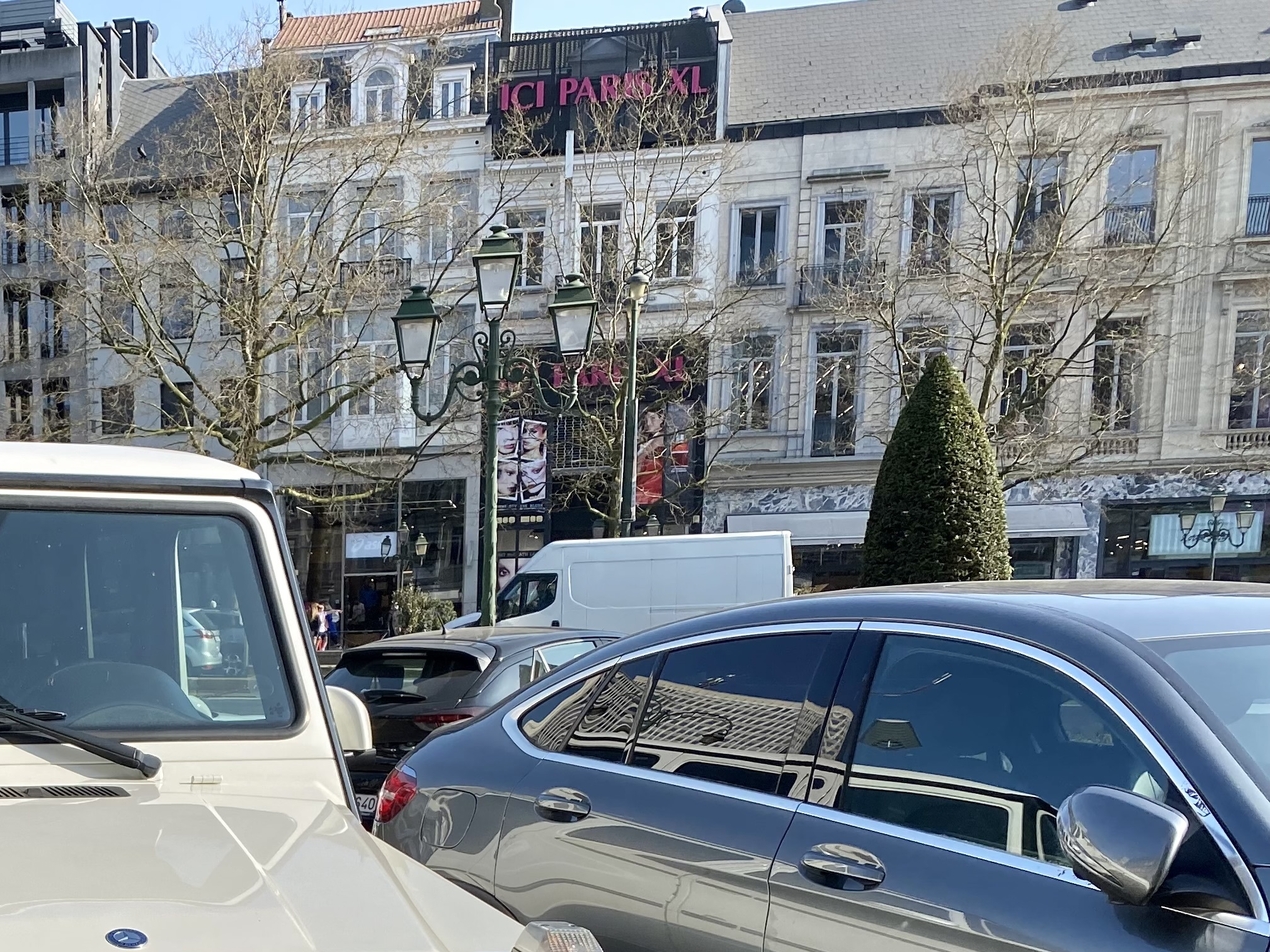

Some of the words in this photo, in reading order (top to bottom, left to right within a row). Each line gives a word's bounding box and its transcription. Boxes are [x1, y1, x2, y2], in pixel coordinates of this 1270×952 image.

[498, 80, 545, 111] ICI
[560, 69, 652, 106] PARIS
[667, 65, 708, 97] XL
